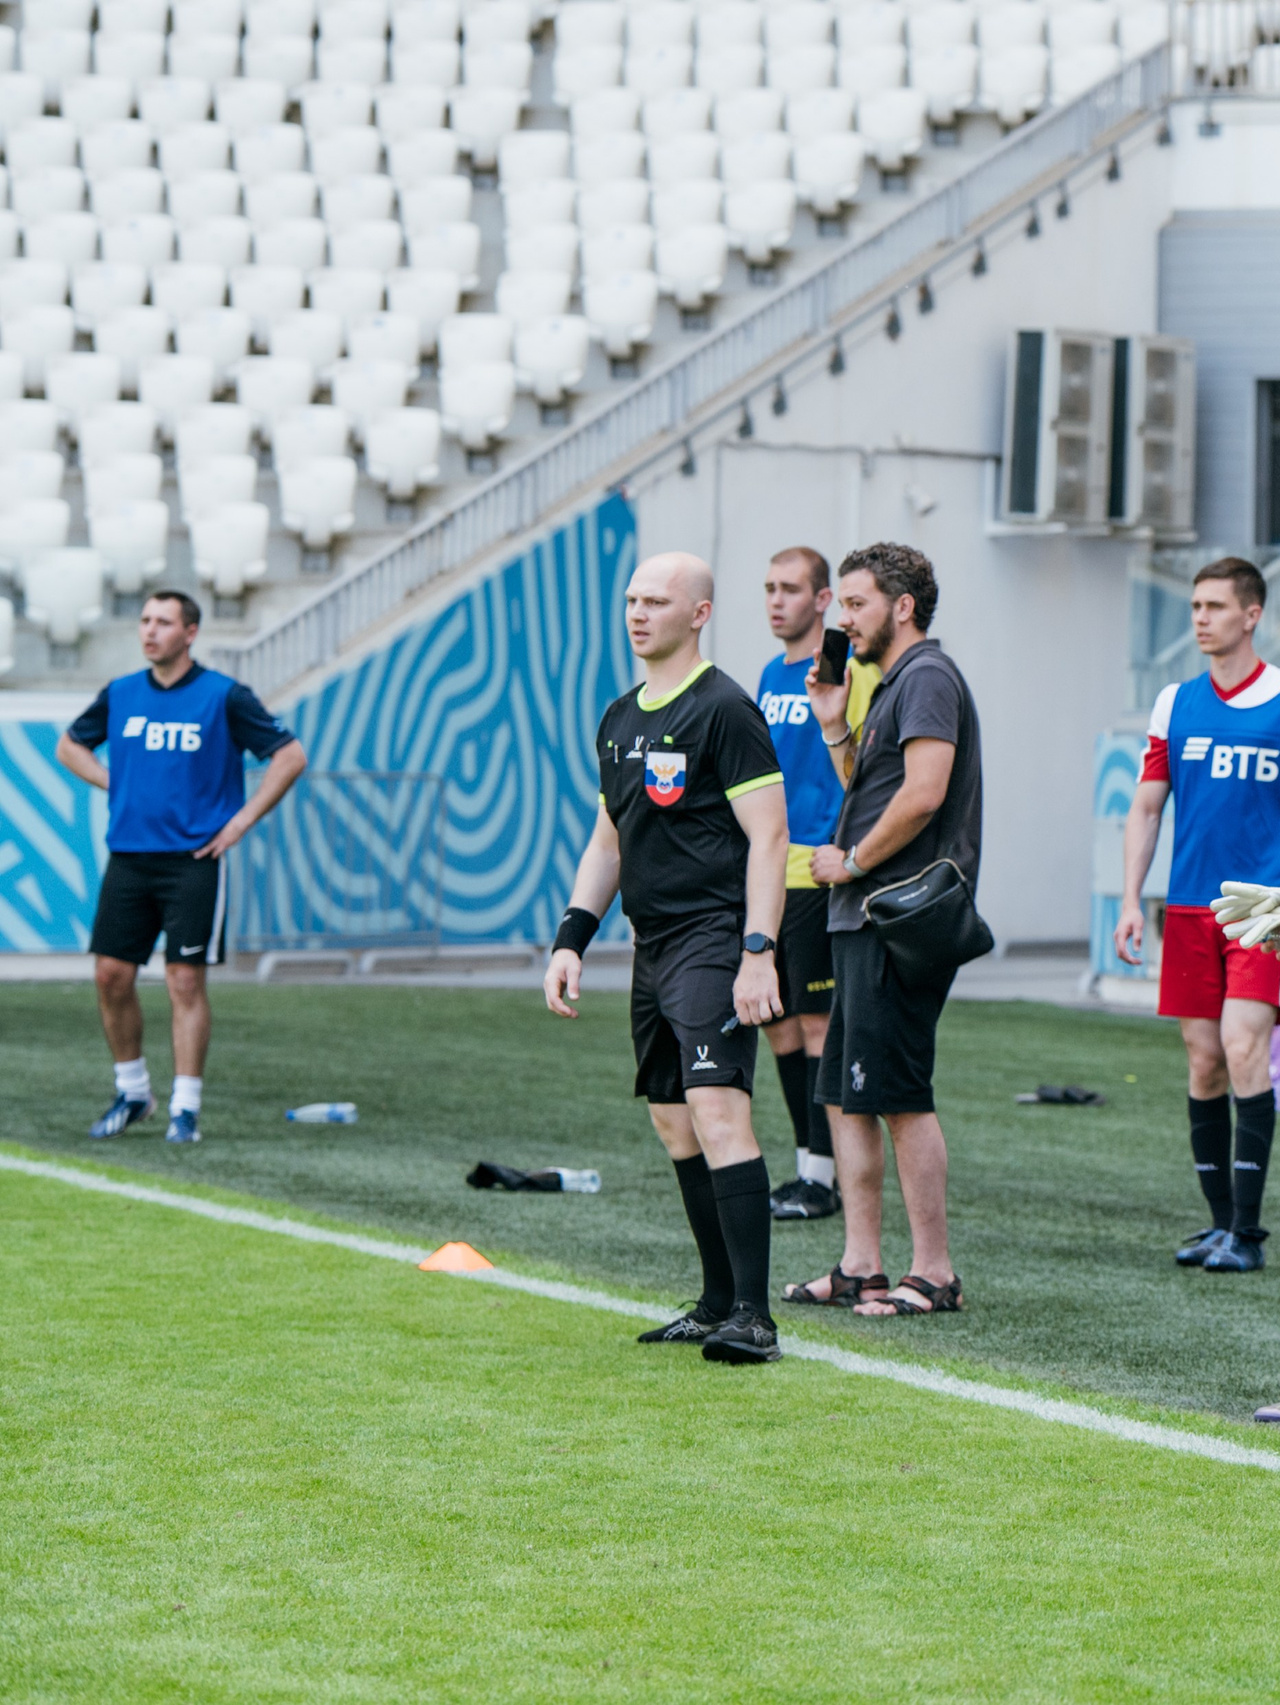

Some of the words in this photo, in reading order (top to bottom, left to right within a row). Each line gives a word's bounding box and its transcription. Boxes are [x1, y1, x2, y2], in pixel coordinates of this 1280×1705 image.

[764, 693, 811, 726] ВТБ
[145, 721, 202, 752] ВТБ
[1210, 745, 1280, 783] ВТБ
